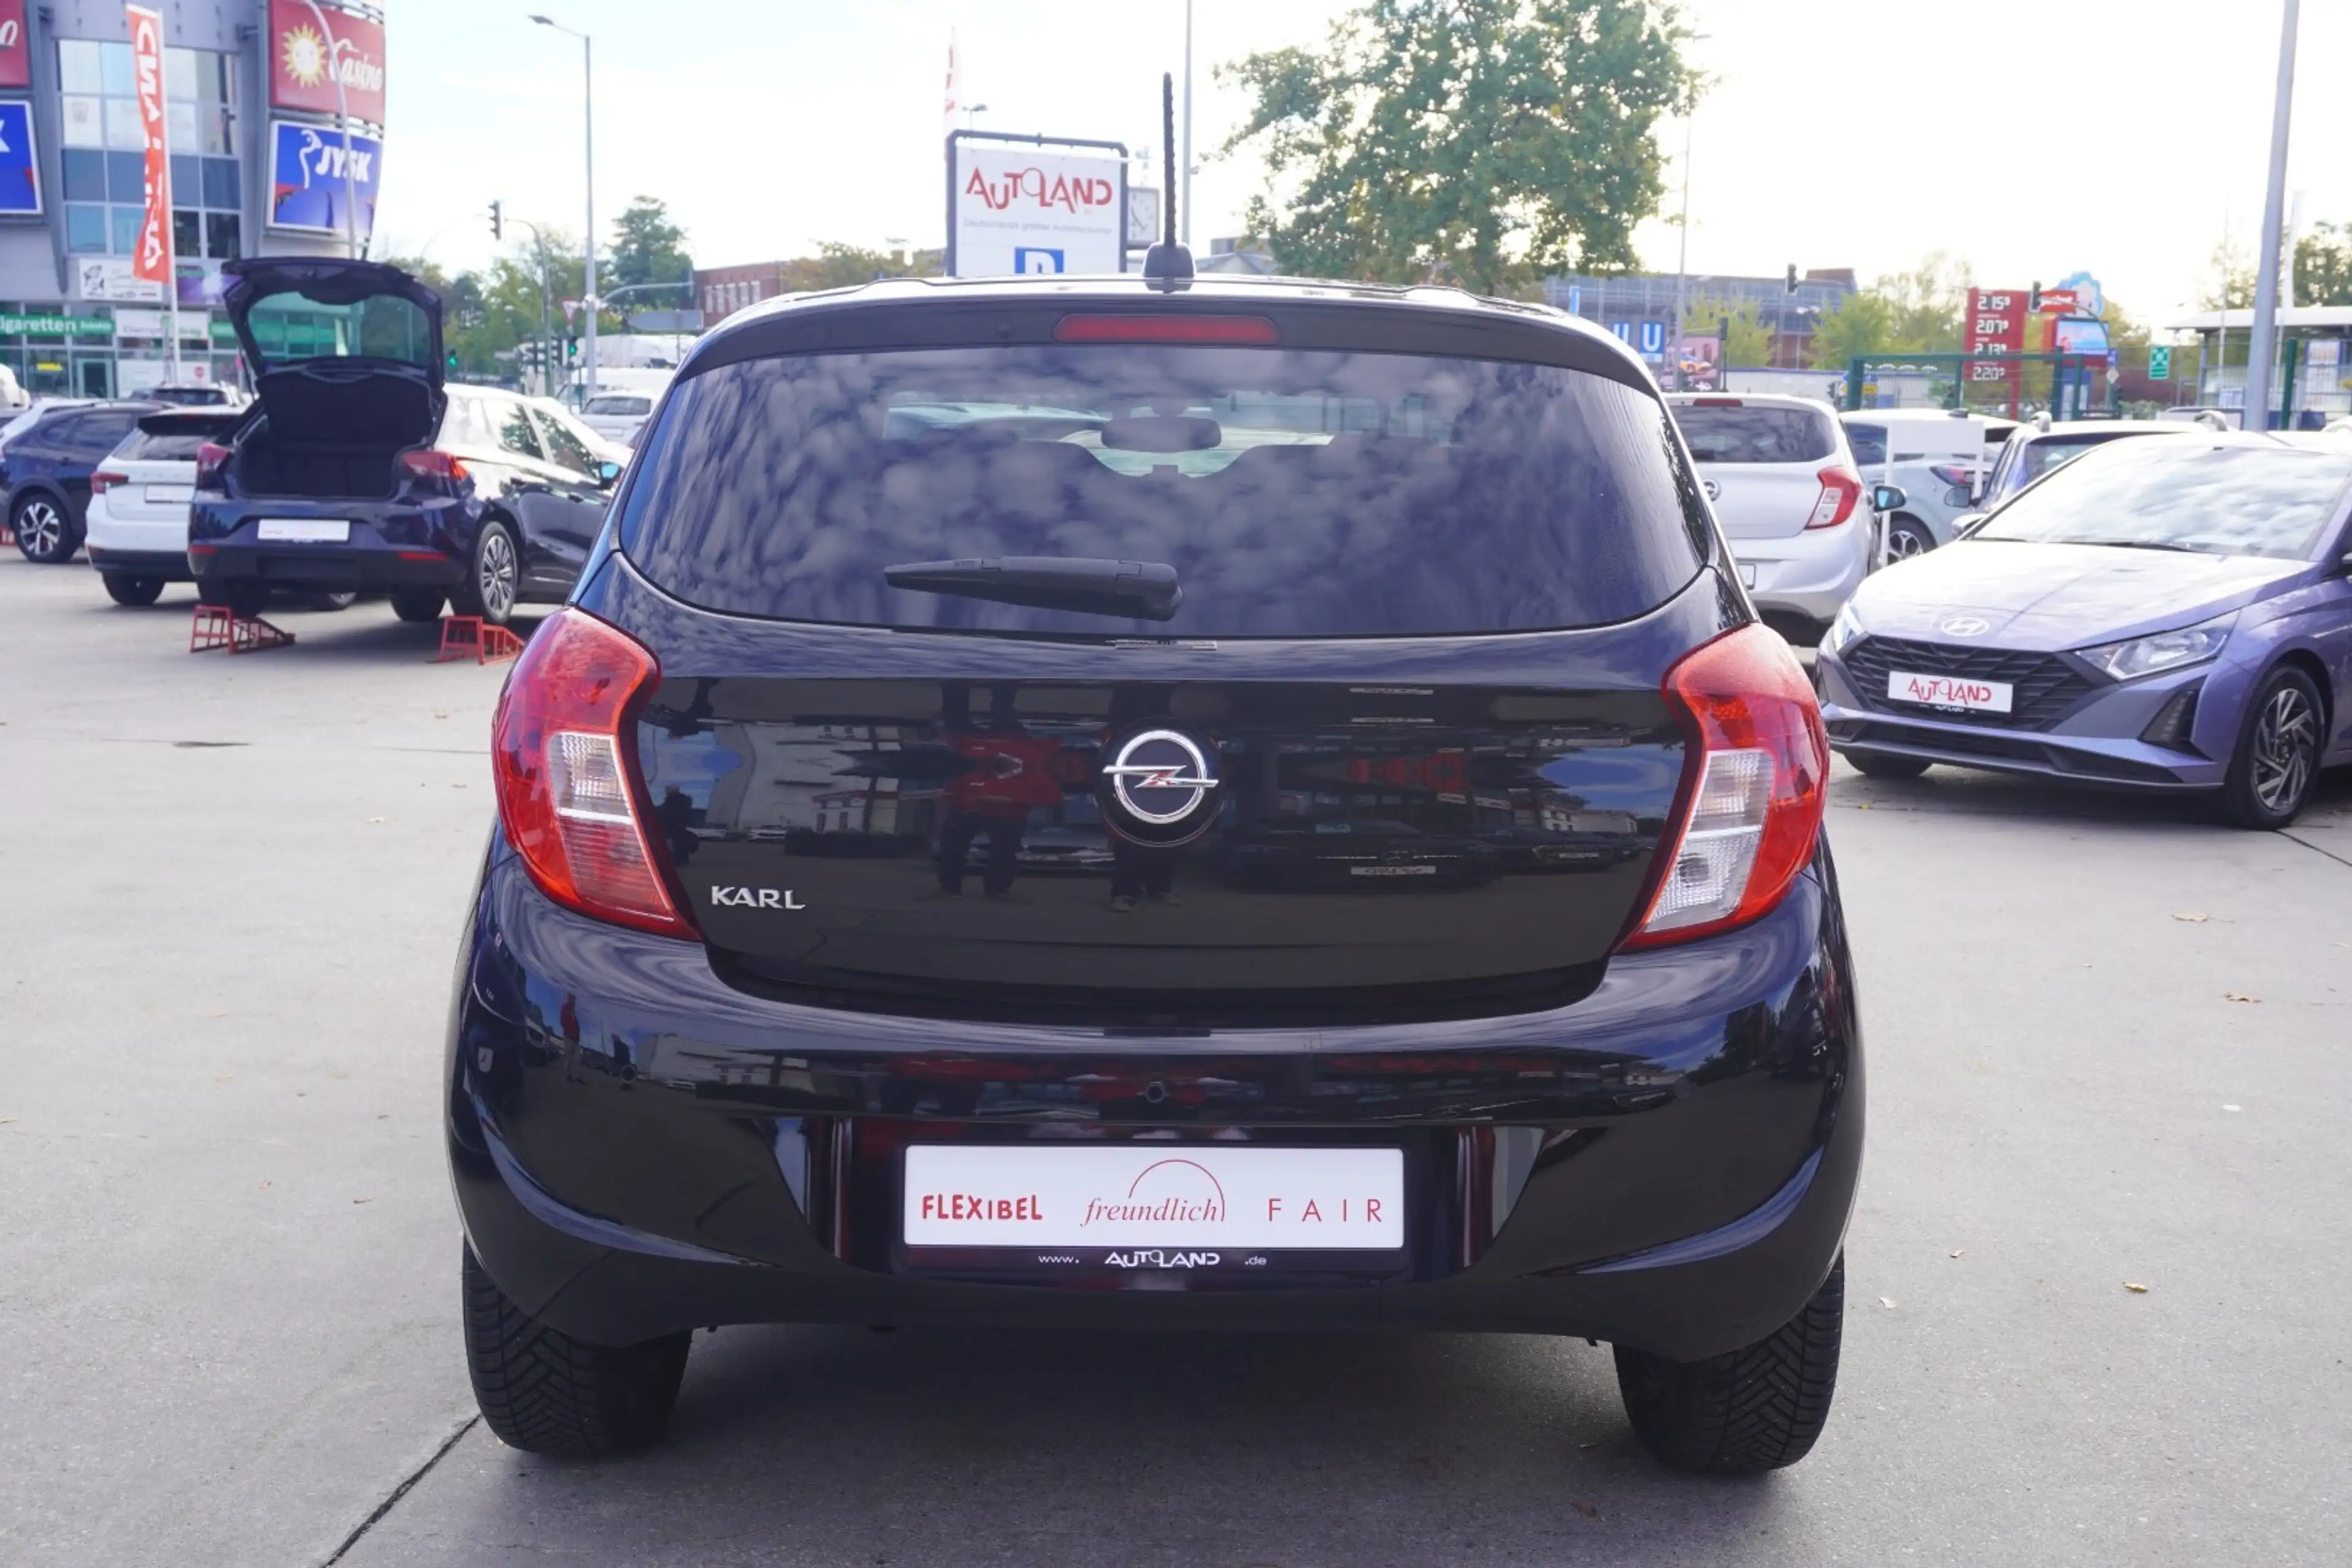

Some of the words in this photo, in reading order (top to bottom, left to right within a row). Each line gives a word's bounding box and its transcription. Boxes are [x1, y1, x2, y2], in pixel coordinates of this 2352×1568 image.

[965, 165, 1113, 214] AUTOLAND
[1643, 323, 1661, 352] U
[1908, 677, 1992, 706] AUTOLAND
[710, 885, 805, 910] KARL
[922, 1194, 1043, 1221] FLEXIBEL
[1080, 1196, 1224, 1227] freundlich
[1038, 1256, 1080, 1264] www.
[1104, 1250, 1221, 1268] AUTOLAND
[1245, 1256, 1267, 1266] .de
